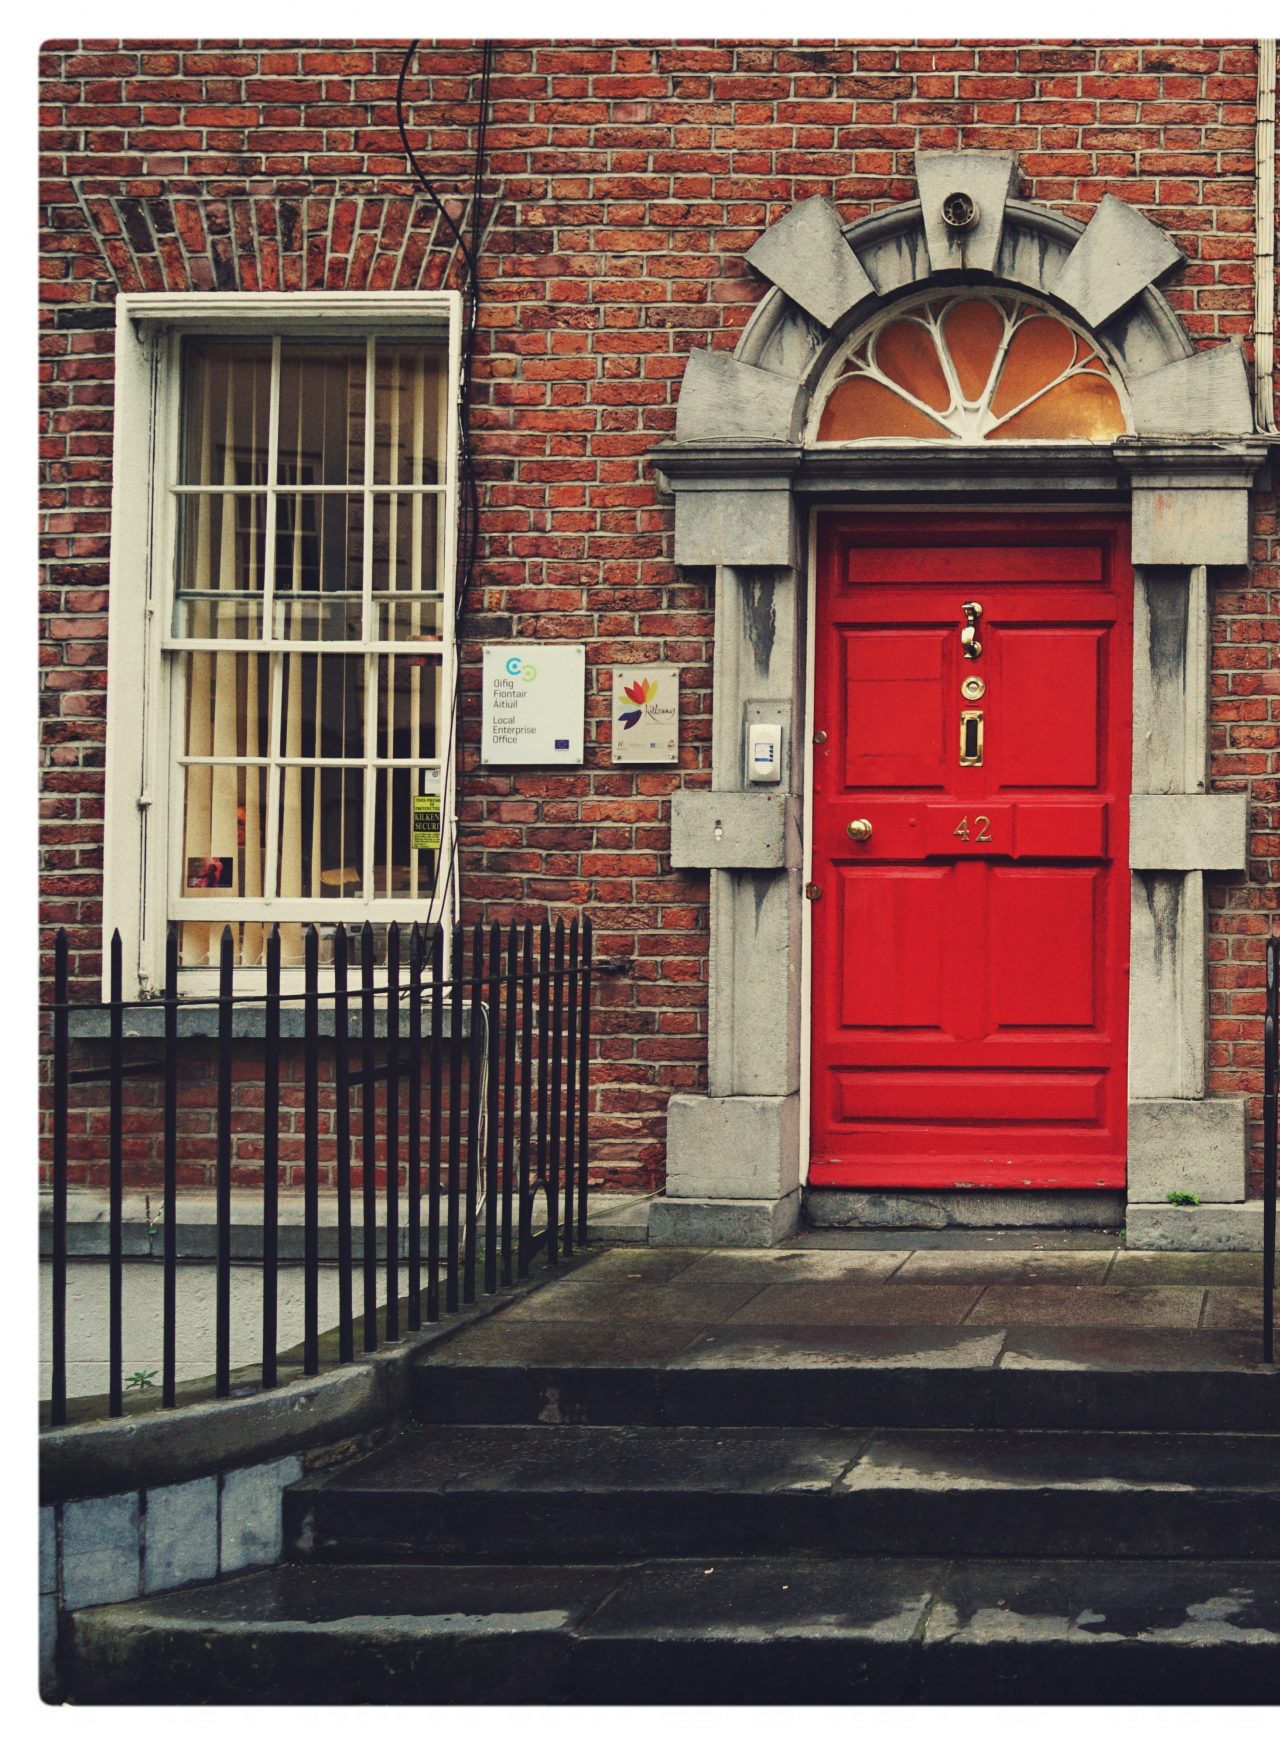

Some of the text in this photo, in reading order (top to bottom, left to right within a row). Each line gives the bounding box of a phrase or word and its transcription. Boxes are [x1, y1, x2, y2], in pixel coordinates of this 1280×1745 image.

[493, 679, 514, 689] Oifig
[493, 690, 528, 698] Fiontair
[493, 716, 515, 725] Local
[492, 725, 537, 736] Enterprise
[492, 735, 518, 744] Office
[952, 815, 993, 843] 42
